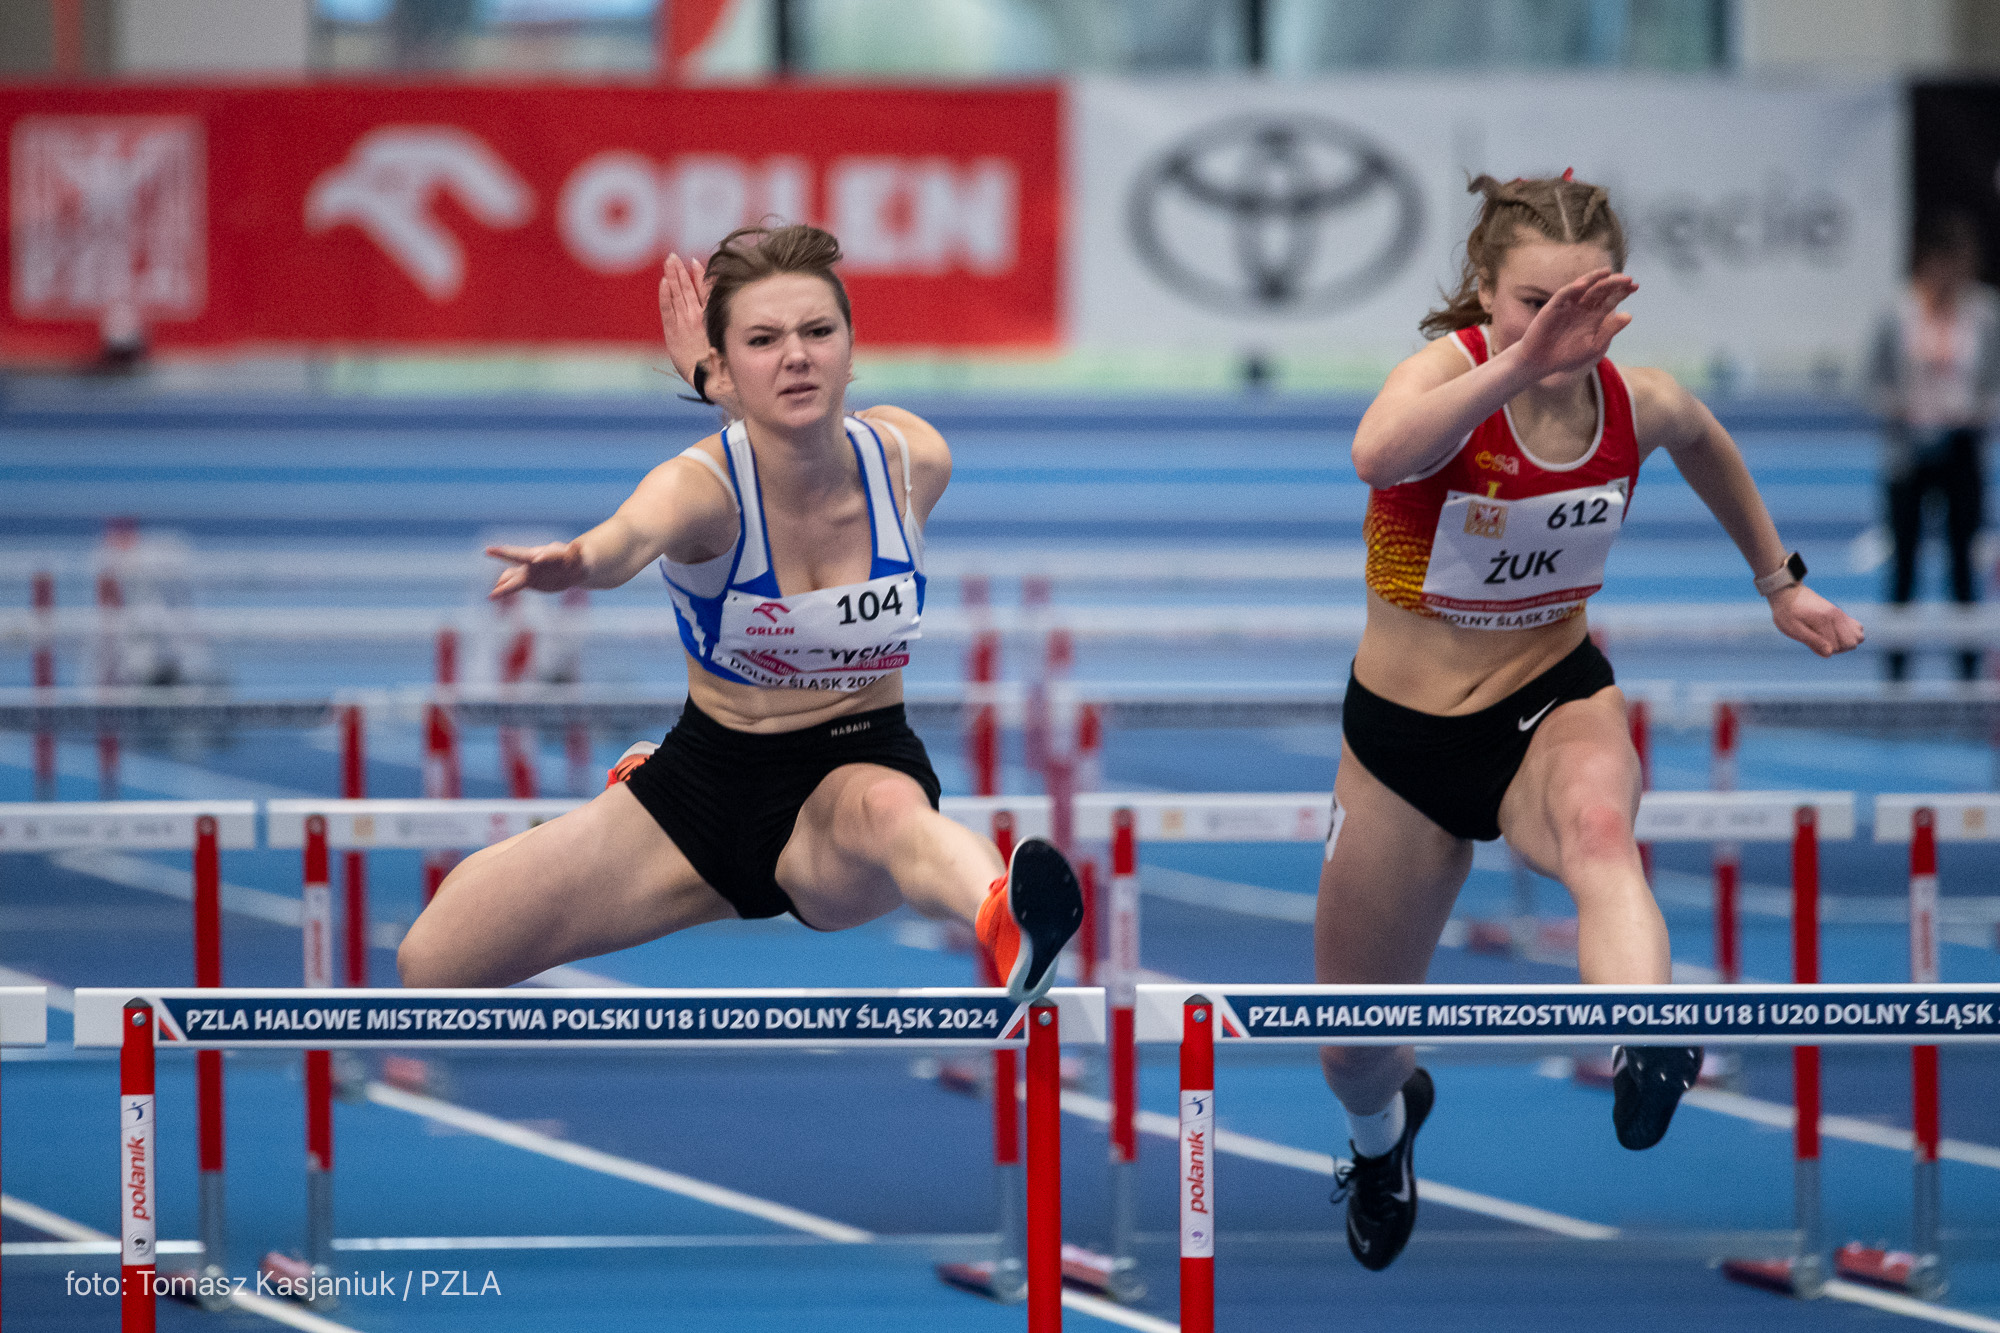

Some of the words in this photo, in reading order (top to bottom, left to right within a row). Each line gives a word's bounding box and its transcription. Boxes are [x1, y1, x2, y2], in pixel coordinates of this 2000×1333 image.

[1547, 498, 1609, 529] 612
[1484, 549, 1564, 585] ŻUK
[836, 585, 903, 626] 104
[745, 626, 795, 636] ORLEN
[847, 673, 886, 688] 202
[186, 1009, 249, 1031] PZLA
[255, 1009, 361, 1030] HALOWE
[367, 1009, 547, 1030] MISTRZOSTWA
[553, 1009, 639, 1030] POLSKI
[646, 1009, 693, 1030] U18
[699, 1008, 706, 1029] i
[712, 1008, 760, 1029] U20
[766, 1008, 851, 1029] DOLNY
[857, 1004, 933, 1034] ŚLĄSK
[939, 1009, 999, 1029] 2024
[1248, 1006, 1308, 1027] PZLA
[1317, 1006, 1422, 1027] HALOWE
[1428, 1005, 1606, 1026] MISTRZOSTWA
[1612, 1004, 1699, 1026] POLSKI
[1705, 1005, 1752, 1025] U18
[1758, 1004, 1765, 1024] i
[1771, 1004, 1819, 1025] U20
[1825, 1004, 1911, 1025] DOLNY
[1916, 1000, 1994, 1030] ŚLĄSK
[127, 1136, 150, 1221] polanik
[1187, 1130, 1208, 1215] polanik
